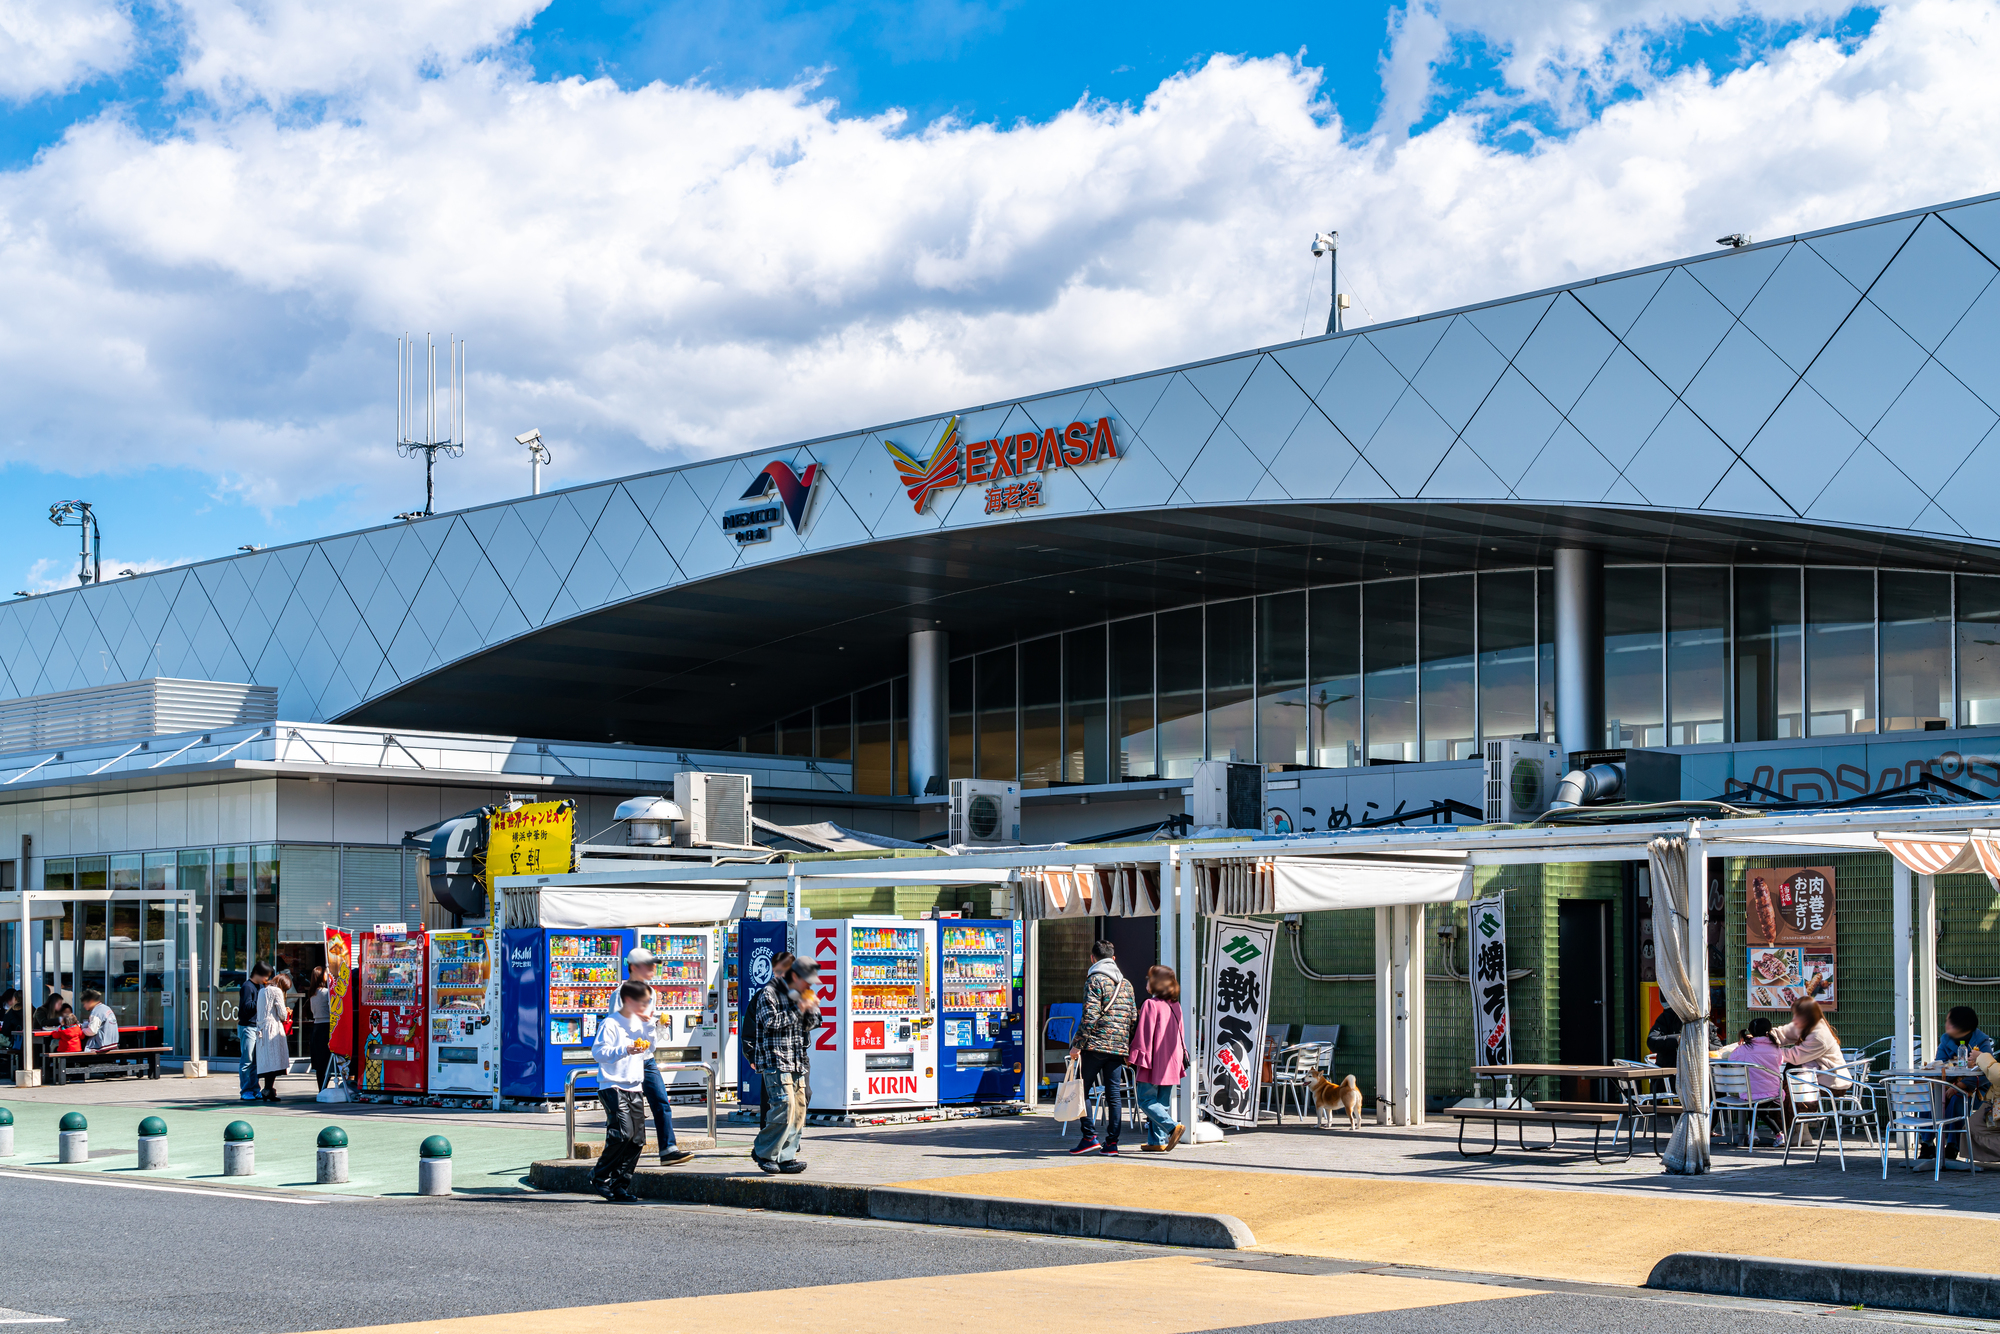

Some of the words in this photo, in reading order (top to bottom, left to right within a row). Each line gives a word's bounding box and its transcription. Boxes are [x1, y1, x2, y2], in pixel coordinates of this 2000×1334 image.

[966, 417, 1119, 484] EXPASA
[984, 480, 1043, 515] 海老名
[723, 508, 777, 529] NEXCO
[735, 528, 765, 542] 中日本
[507, 809, 569, 828] 世界チャンピオン
[512, 829, 548, 843] 横浜中華街
[1794, 876, 1808, 931] おにぎり
[1808, 876, 1825, 931] 肉巻き
[511, 946, 532, 960] Asahi
[751, 946, 774, 959] COFFEE
[815, 928, 837, 1051] KIRIN
[855, 1036, 882, 1046] 午後の紅茶
[868, 1076, 917, 1095] KIRIN
